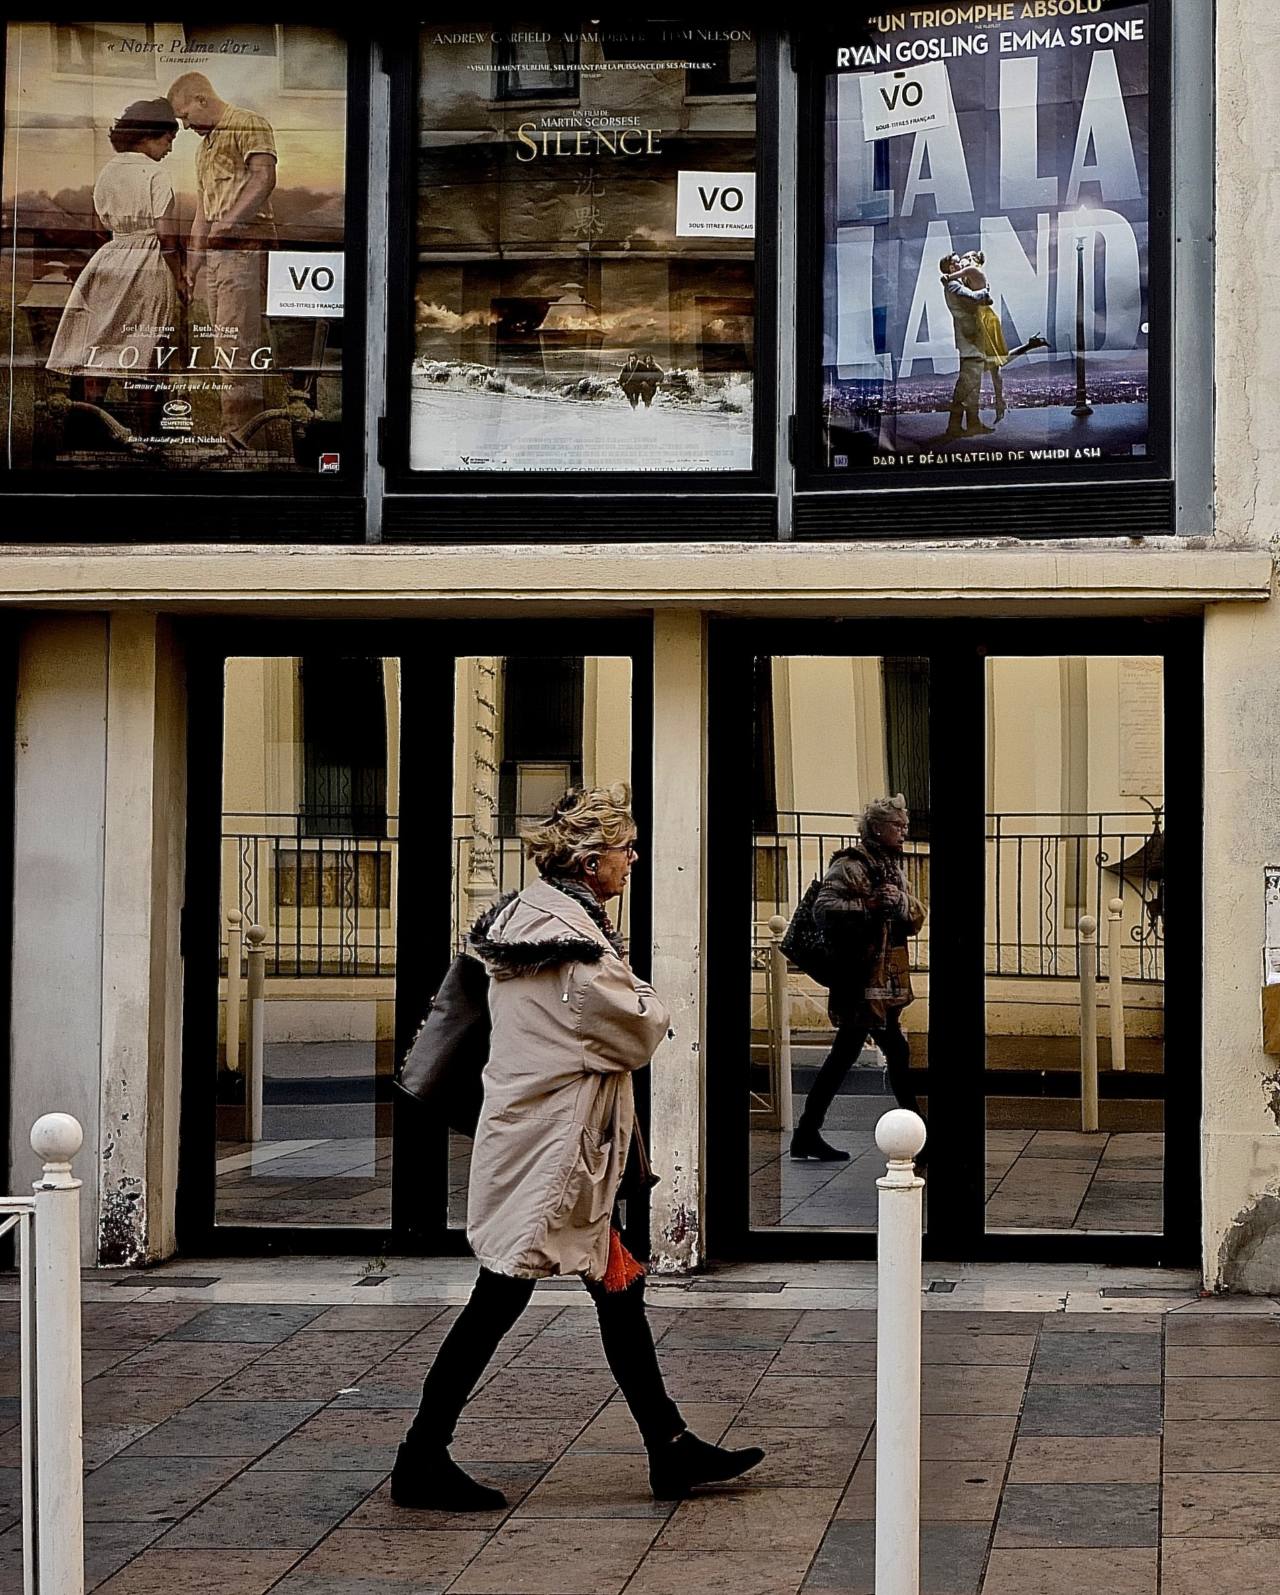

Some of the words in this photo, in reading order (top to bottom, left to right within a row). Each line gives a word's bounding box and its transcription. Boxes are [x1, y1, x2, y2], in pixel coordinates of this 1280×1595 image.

[911, 3, 1014, 29] TRIOMPHE
[120, 39, 164, 52] Notre
[170, 40, 214, 53] Palme
[432, 32, 489, 44] ANDREW
[491, 32, 551, 43] GRFIELD
[560, 32, 598, 43] ADAM
[696, 30, 751, 41] NEESON
[837, 44, 890, 67] RYAN
[896, 34, 988, 62] GOSLING
[1000, 28, 1065, 52] EMMA
[1070, 20, 1144, 46] STONE
[880, 82, 922, 110] VO
[542, 118, 582, 127] MARTIN
[586, 116, 640, 127] SCORSESE
[516, 122, 662, 162] SILENCE
[837, 62, 974, 221] LA
[1000, 50, 1142, 209] LA
[698, 187, 744, 211] VO
[288, 266, 334, 291] VO
[837, 209, 1141, 380] LAND
[121, 325, 137, 333] Joel
[193, 324, 211, 332] Ruth
[214, 325, 239, 333] Negga
[84, 346, 273, 369] LOVING
[873, 455, 895, 465] PAR
